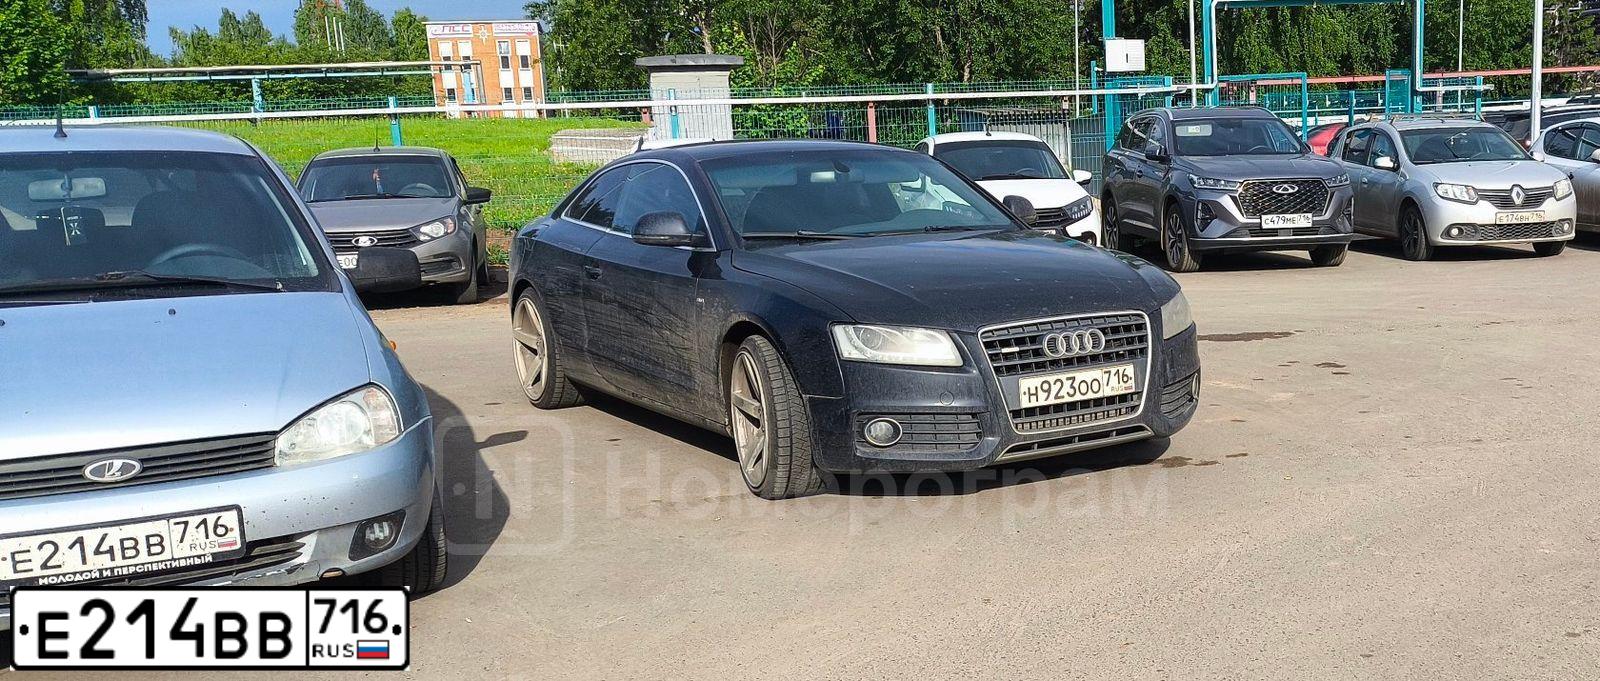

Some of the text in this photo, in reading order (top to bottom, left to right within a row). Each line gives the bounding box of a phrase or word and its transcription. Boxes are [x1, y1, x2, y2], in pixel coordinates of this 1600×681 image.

[1027, 368, 1130, 404] Н923ОО 716
[10, 515, 229, 575] Е214ВВ 716
[189, 540, 217, 552] RUS
[38, 553, 214, 586] МОЛОДОЙ И ПЕРСПЕКТИВНЫЙ
